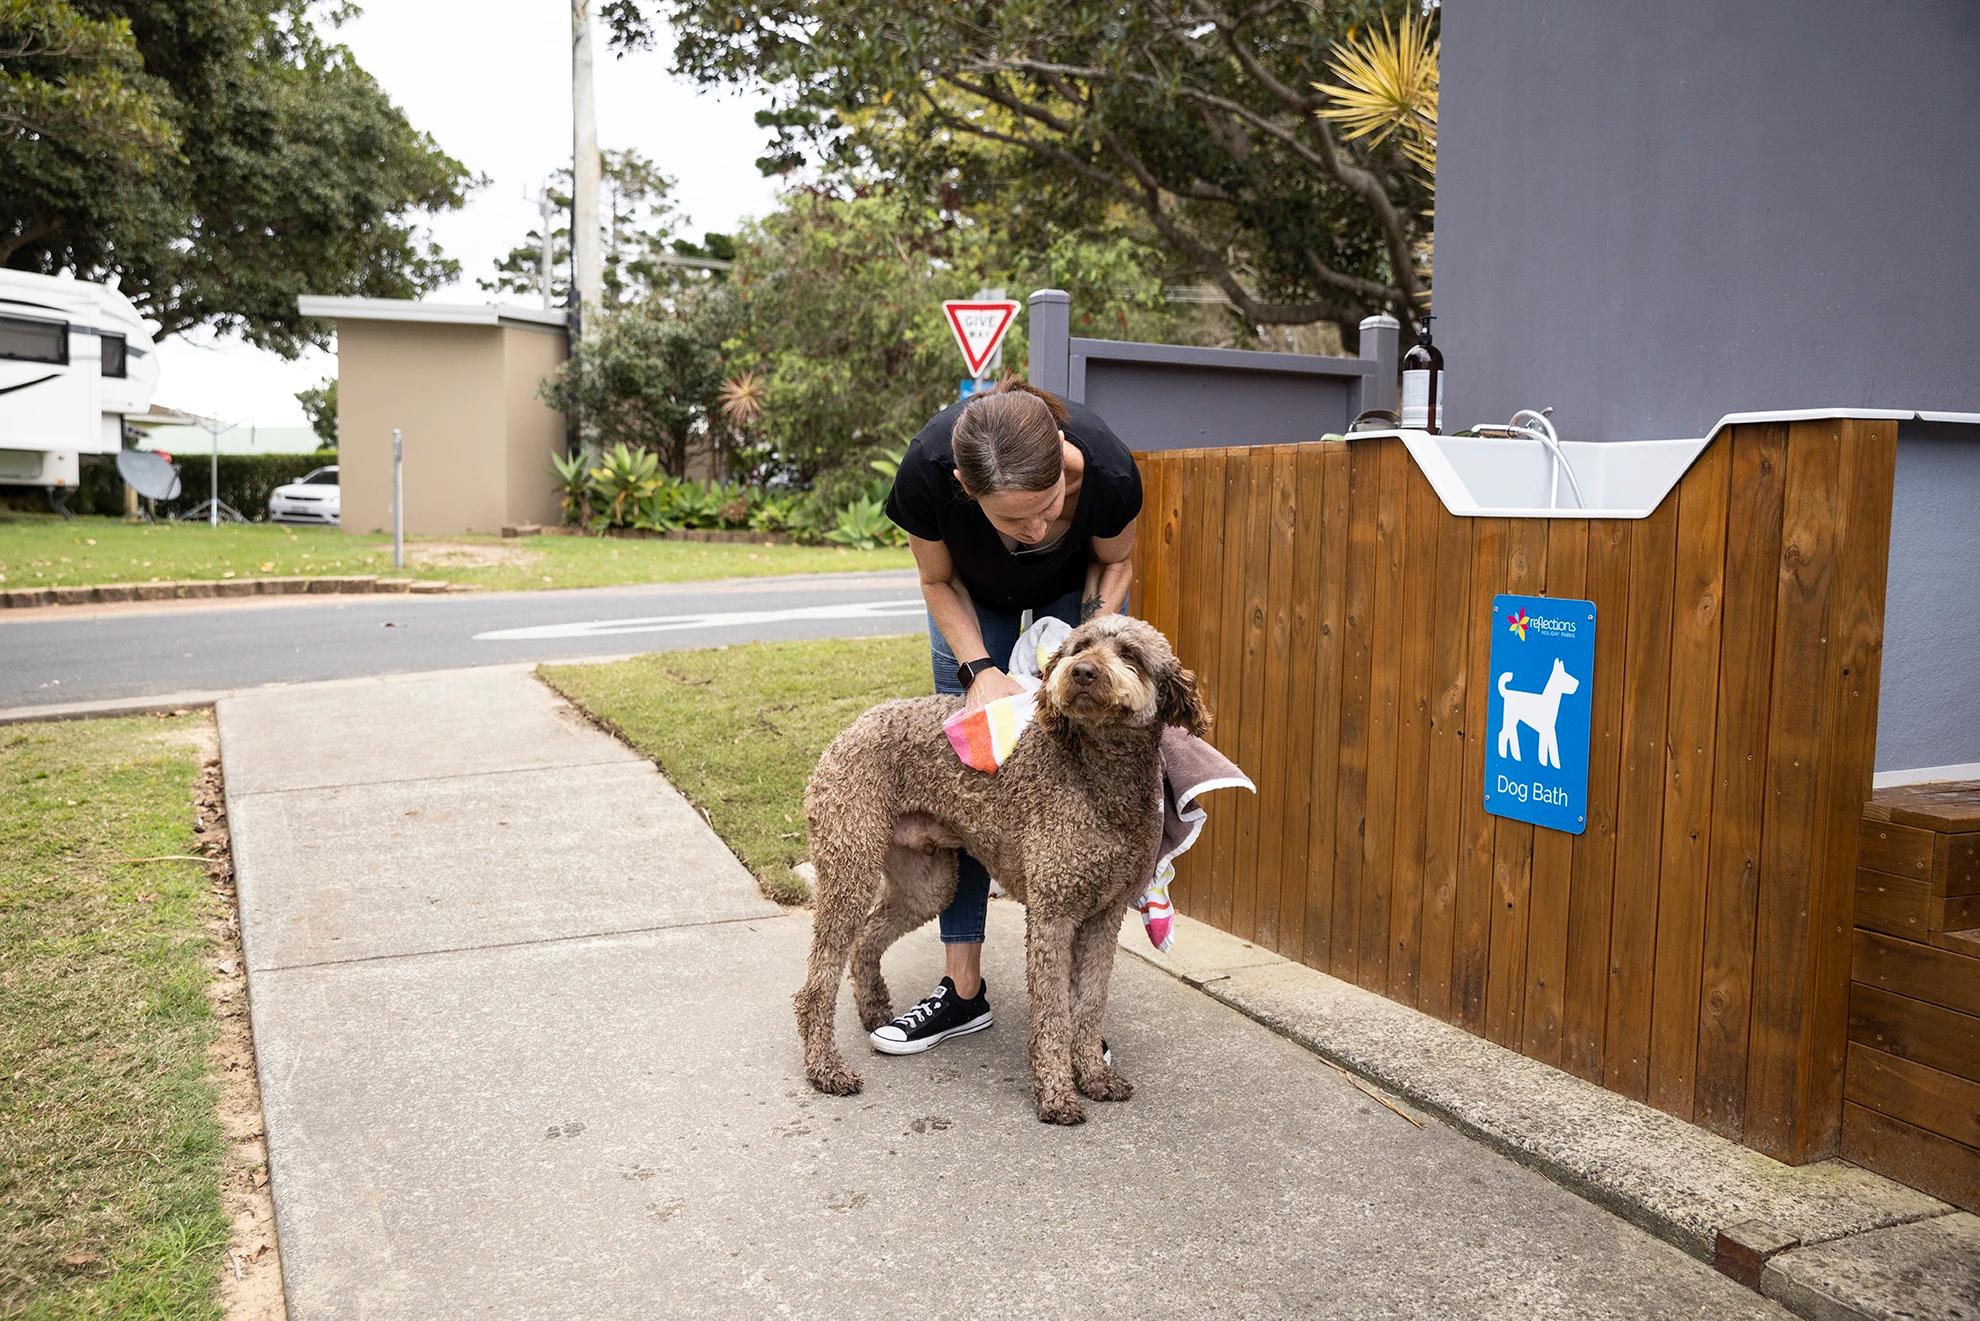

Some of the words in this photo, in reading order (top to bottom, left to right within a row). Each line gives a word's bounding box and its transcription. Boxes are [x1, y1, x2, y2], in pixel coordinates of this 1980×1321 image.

[964, 316, 996, 328] GIVE
[969, 330, 991, 339] WAY
[1529, 616, 1576, 632] reflections
[1561, 631, 1576, 639] PARKS
[1497, 774, 1528, 803] Dog
[1532, 782, 1568, 807] Bath
